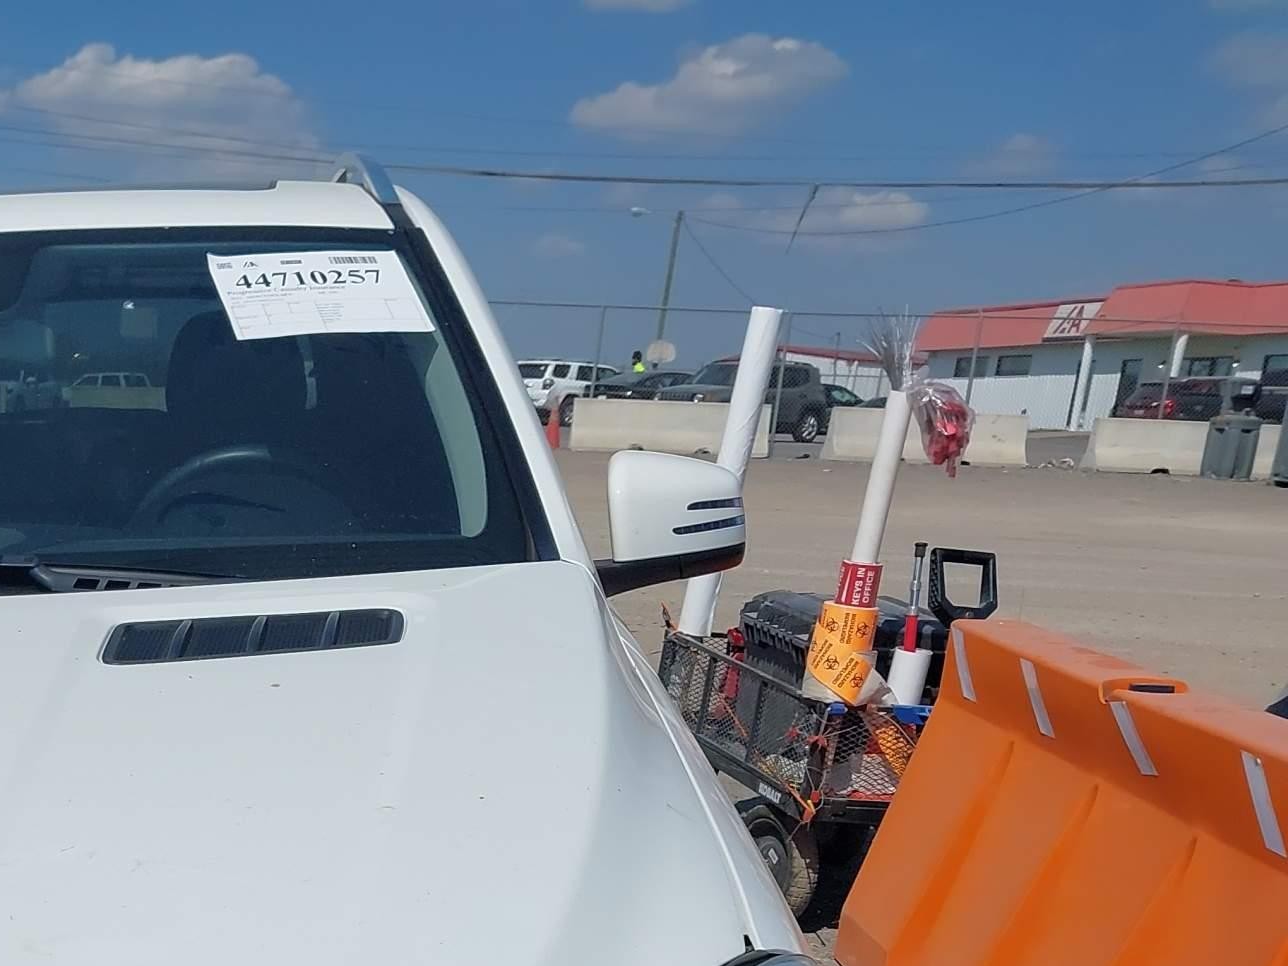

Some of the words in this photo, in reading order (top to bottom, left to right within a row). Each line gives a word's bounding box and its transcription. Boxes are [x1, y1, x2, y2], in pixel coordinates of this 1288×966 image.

[235, 268, 380, 288] 44710257
[856, 567, 866, 577] IN
[851, 580, 864, 604] KEYS
[862, 570, 875, 604] OFFICE
